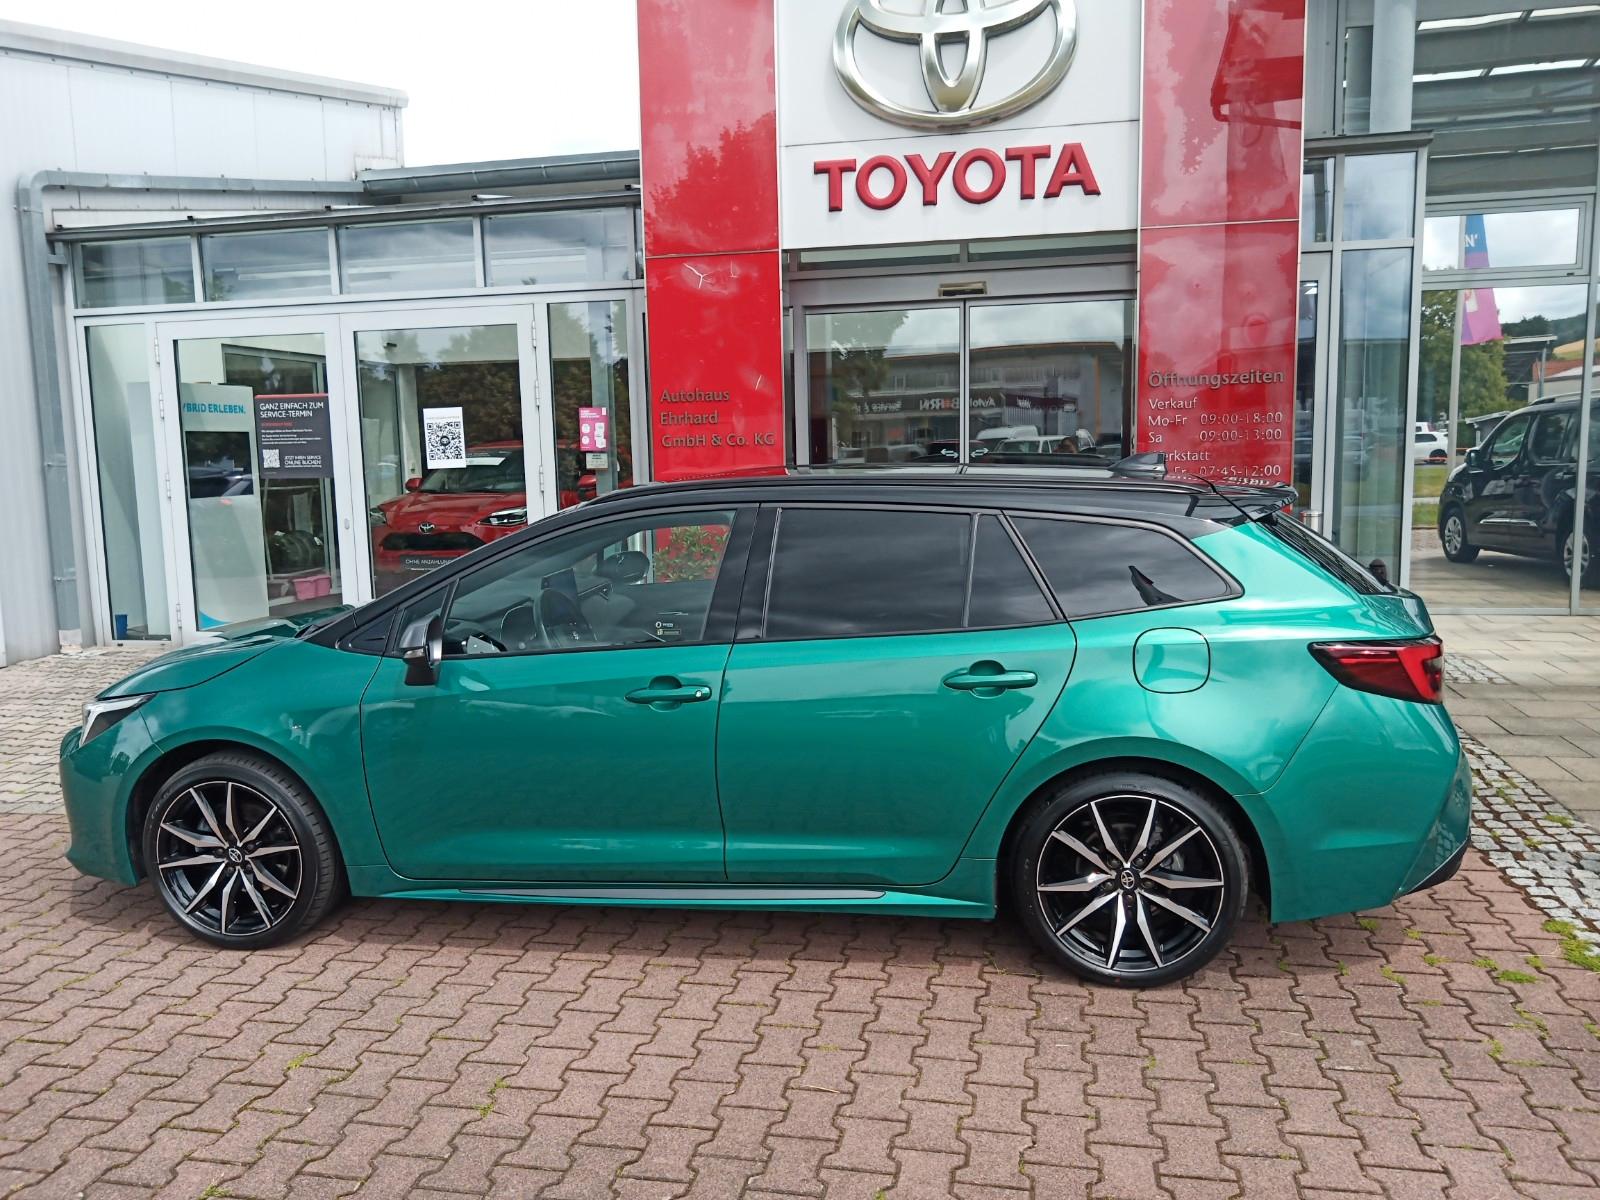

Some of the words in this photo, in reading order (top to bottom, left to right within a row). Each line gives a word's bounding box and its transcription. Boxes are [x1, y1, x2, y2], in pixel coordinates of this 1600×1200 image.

[813, 142, 1101, 212] TOYOTA
[1148, 370, 1285, 389] Öffnungszeiten
[660, 388, 730, 403] Autohaus
[208, 403, 247, 415] ERLEBEN.
[259, 402, 279, 411] GANZ
[280, 402, 308, 410] EINFACH
[308, 401, 324, 409] ZUM
[1148, 397, 1198, 410] Verkauf
[260, 410, 313, 418] SERVICE-TERMIN
[660, 410, 719, 425] Ehrhard
[1148, 414, 1188, 427] Mo-Fr
[1200, 411, 1283, 424] 09:00-18:00
[661, 434, 706, 448] GmbH
[711, 433, 722, 447] &
[726, 433, 749, 447] Co.
[754, 432, 775, 446] KG
[1148, 431, 1163, 443] Sa
[1199, 428, 1282, 442] 09:00-13:00
[1163, 450, 1210, 461] erkstatt
